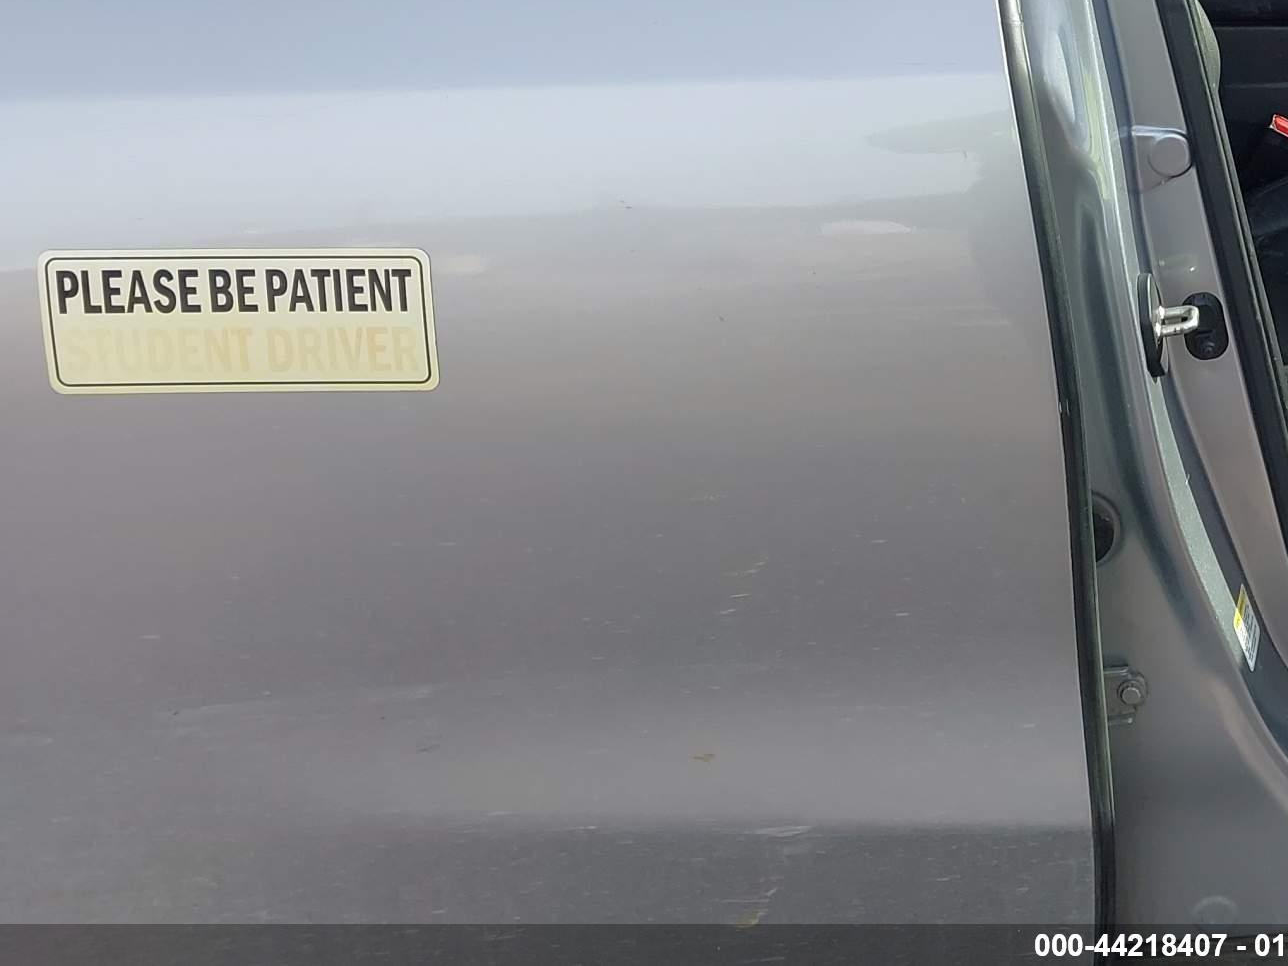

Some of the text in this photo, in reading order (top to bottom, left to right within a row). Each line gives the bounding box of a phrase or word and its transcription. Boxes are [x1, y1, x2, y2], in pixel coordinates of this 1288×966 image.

[55, 267, 412, 315] PLEASE BE PATIENT
[64, 326, 420, 374] STUDENT DRIVER
